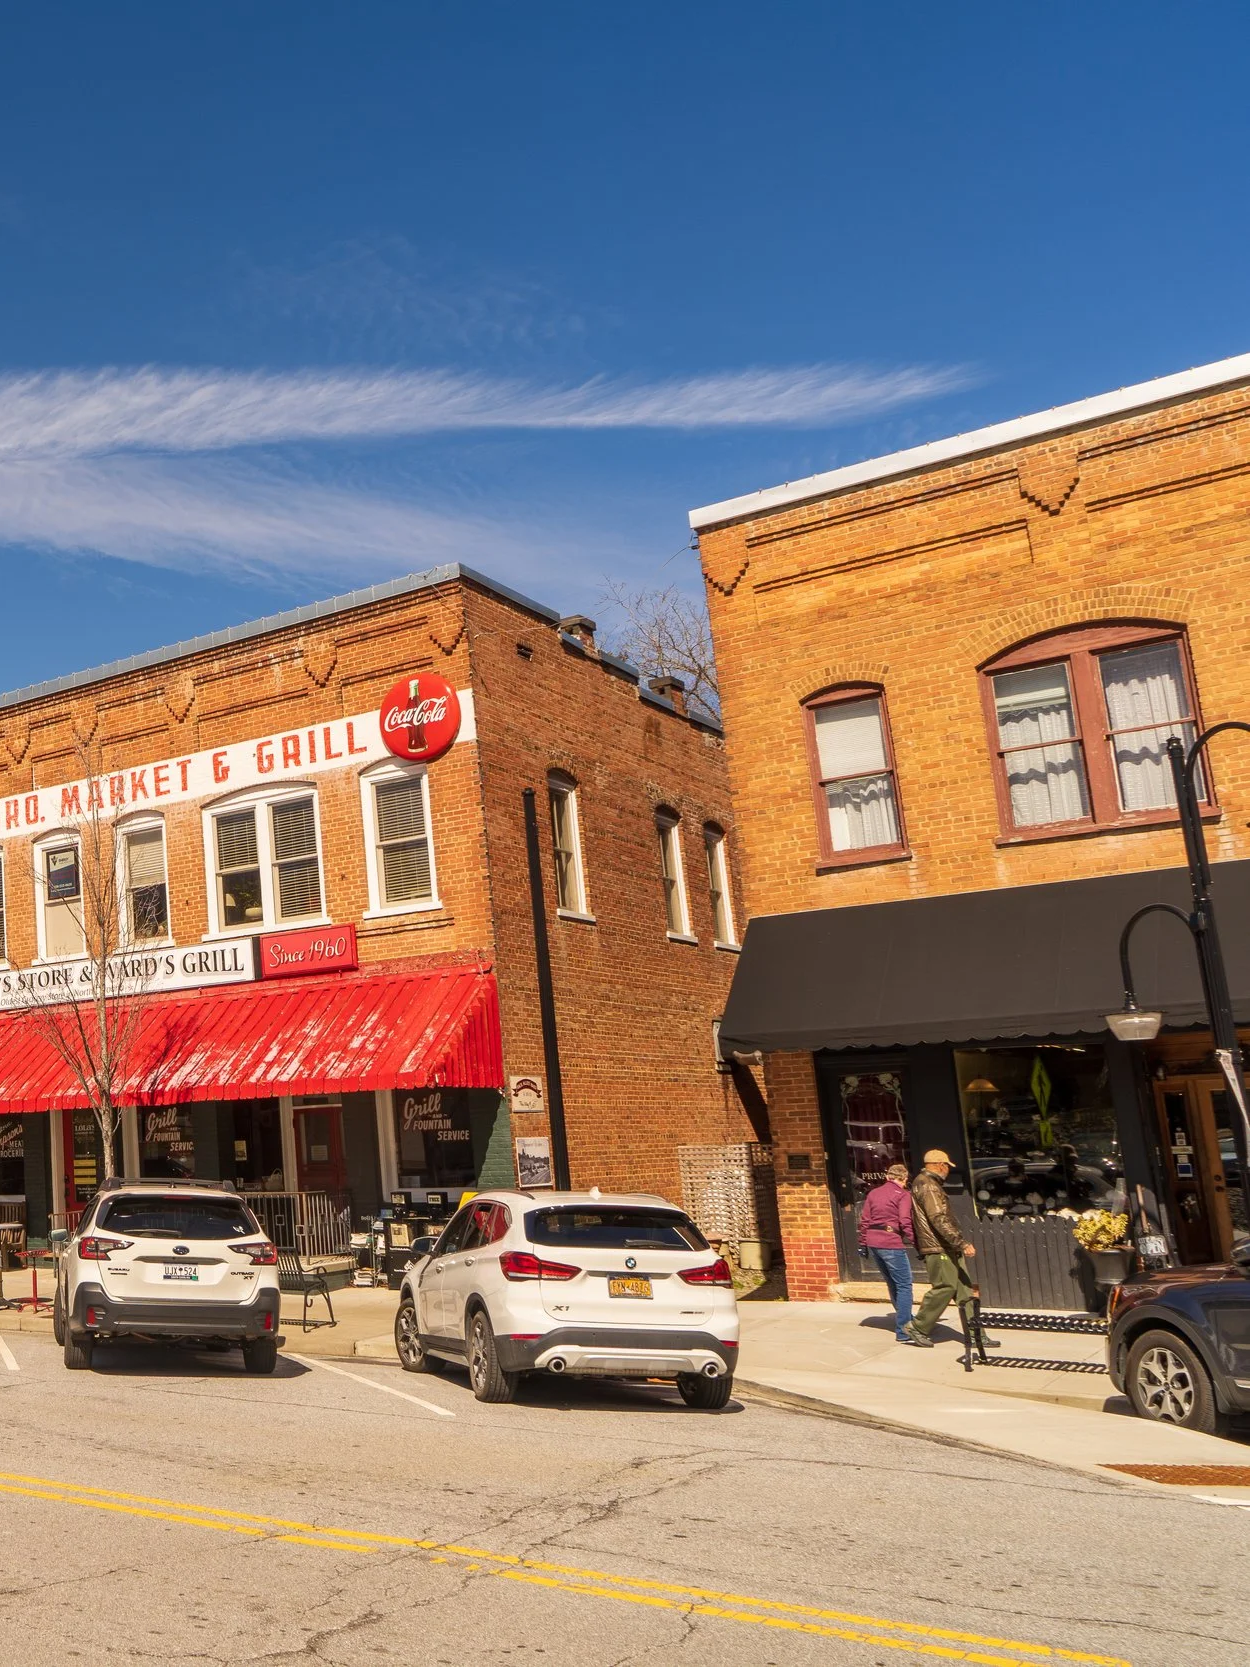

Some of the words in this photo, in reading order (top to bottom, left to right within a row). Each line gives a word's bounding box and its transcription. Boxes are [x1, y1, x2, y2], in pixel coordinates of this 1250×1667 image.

[60, 758, 191, 817] MARKET
[212, 750, 230, 783] &
[256, 721, 368, 774] GRILL
[269, 943, 306, 968] Since
[308, 936, 347, 961] 1960
[17, 966, 74, 990] STORE
[79, 964, 93, 983] &
[182, 946, 245, 975] GRILL
[403, 1092, 441, 1130] Grill
[146, 1107, 178, 1141] Grill
[413, 1119, 452, 1130] FOUNTAIN
[153, 1131, 181, 1142] FOUNTAIN
[437, 1130, 470, 1141] SERVICE
[170, 1141, 194, 1152] SERVIC
[861, 1172, 888, 1181] PRIVA
[164, 1266, 178, 1275] UJX
[183, 1266, 197, 1275] 524
